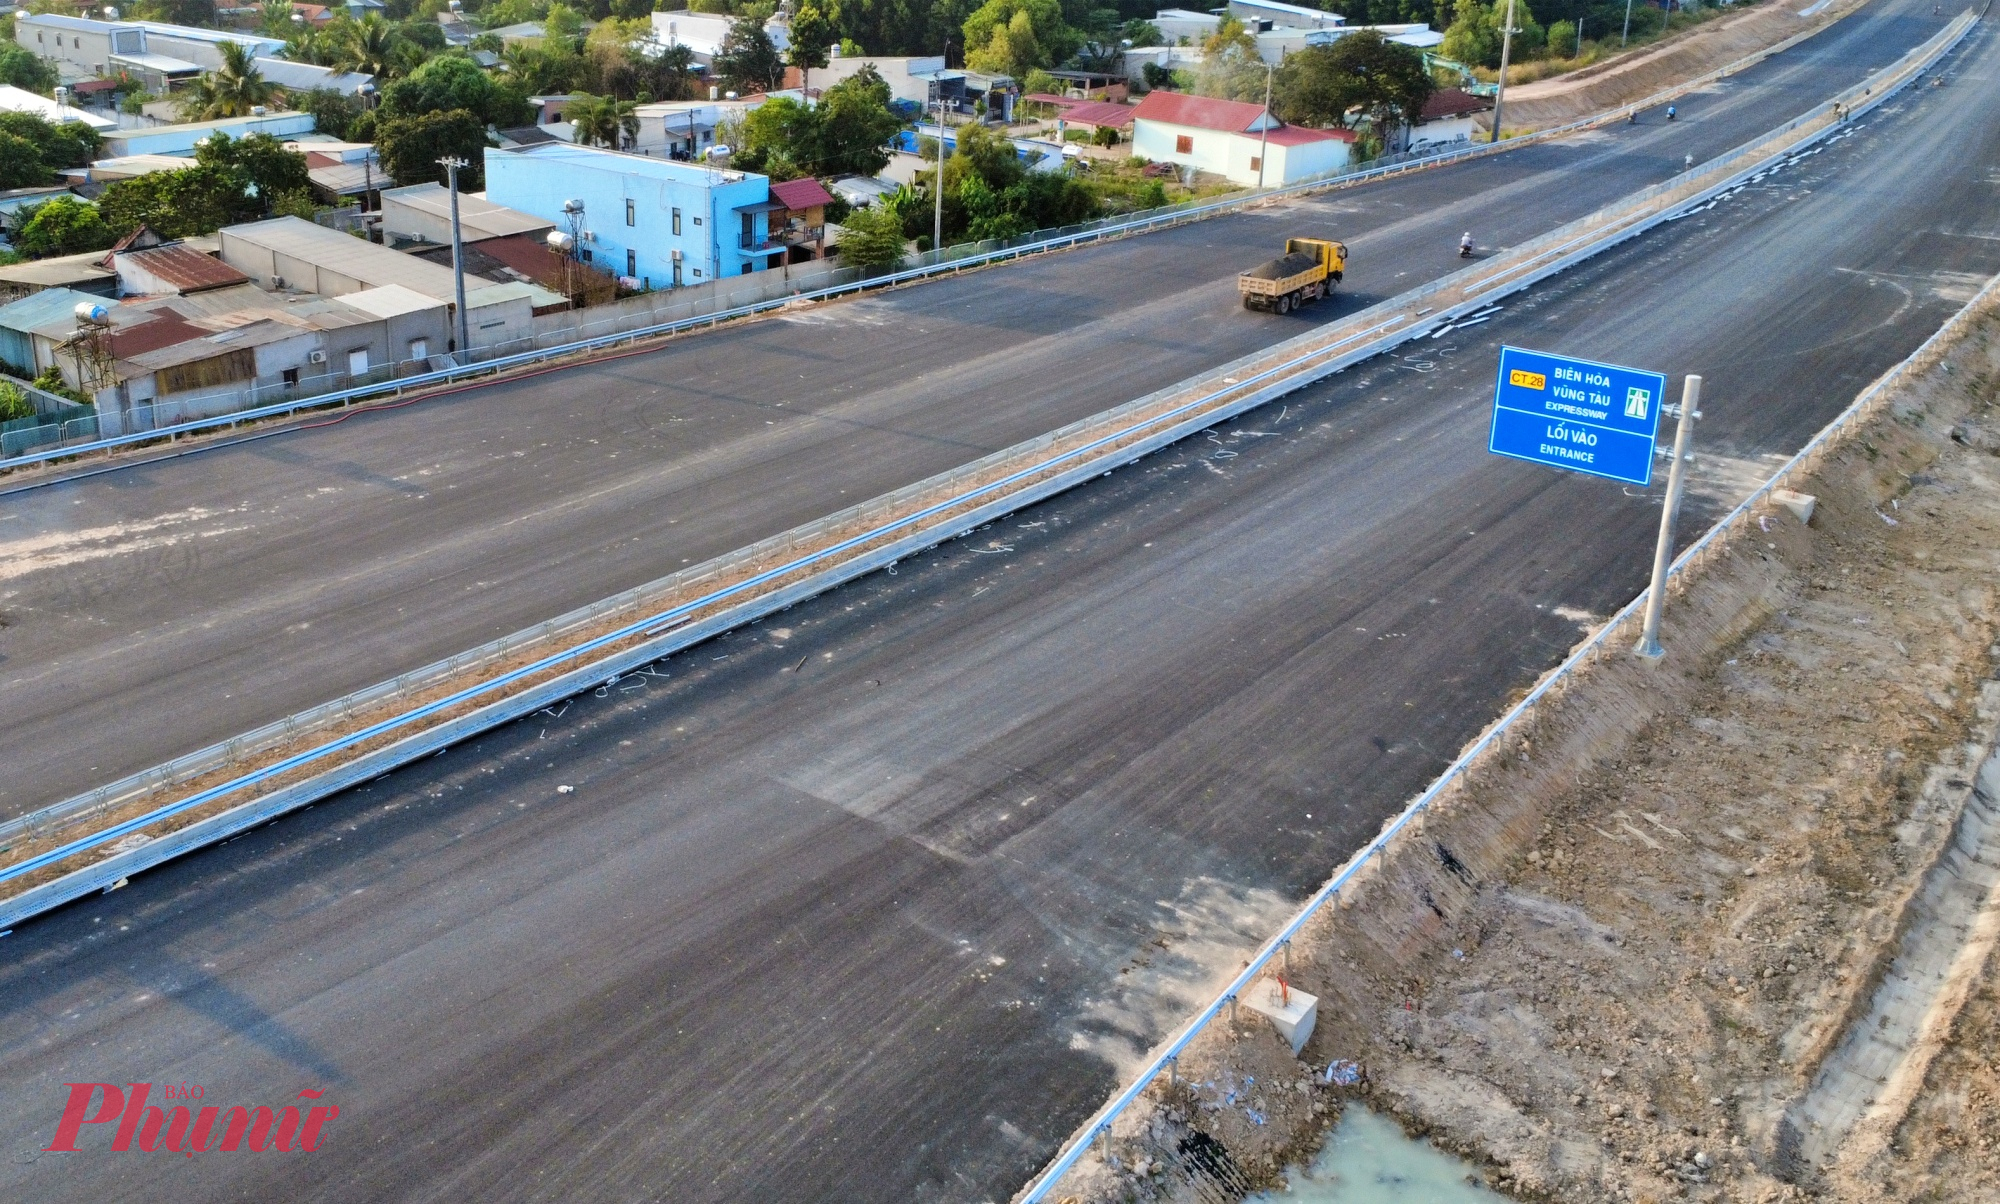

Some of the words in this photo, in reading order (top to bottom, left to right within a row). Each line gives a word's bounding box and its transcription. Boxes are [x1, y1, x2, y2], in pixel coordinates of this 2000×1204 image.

[1511, 372, 1544, 387] CT.28
[1554, 366, 1582, 382] BIÊN
[1585, 372, 1611, 388] HÒA
[1553, 384, 1585, 402] VŨNG
[1588, 390, 1611, 406] TÀU
[1545, 401, 1608, 420] EXPRESSWAY
[1546, 422, 1569, 441] LỐI
[1571, 427, 1598, 446] VÀO
[1539, 443, 1595, 463] ENTRANCE
